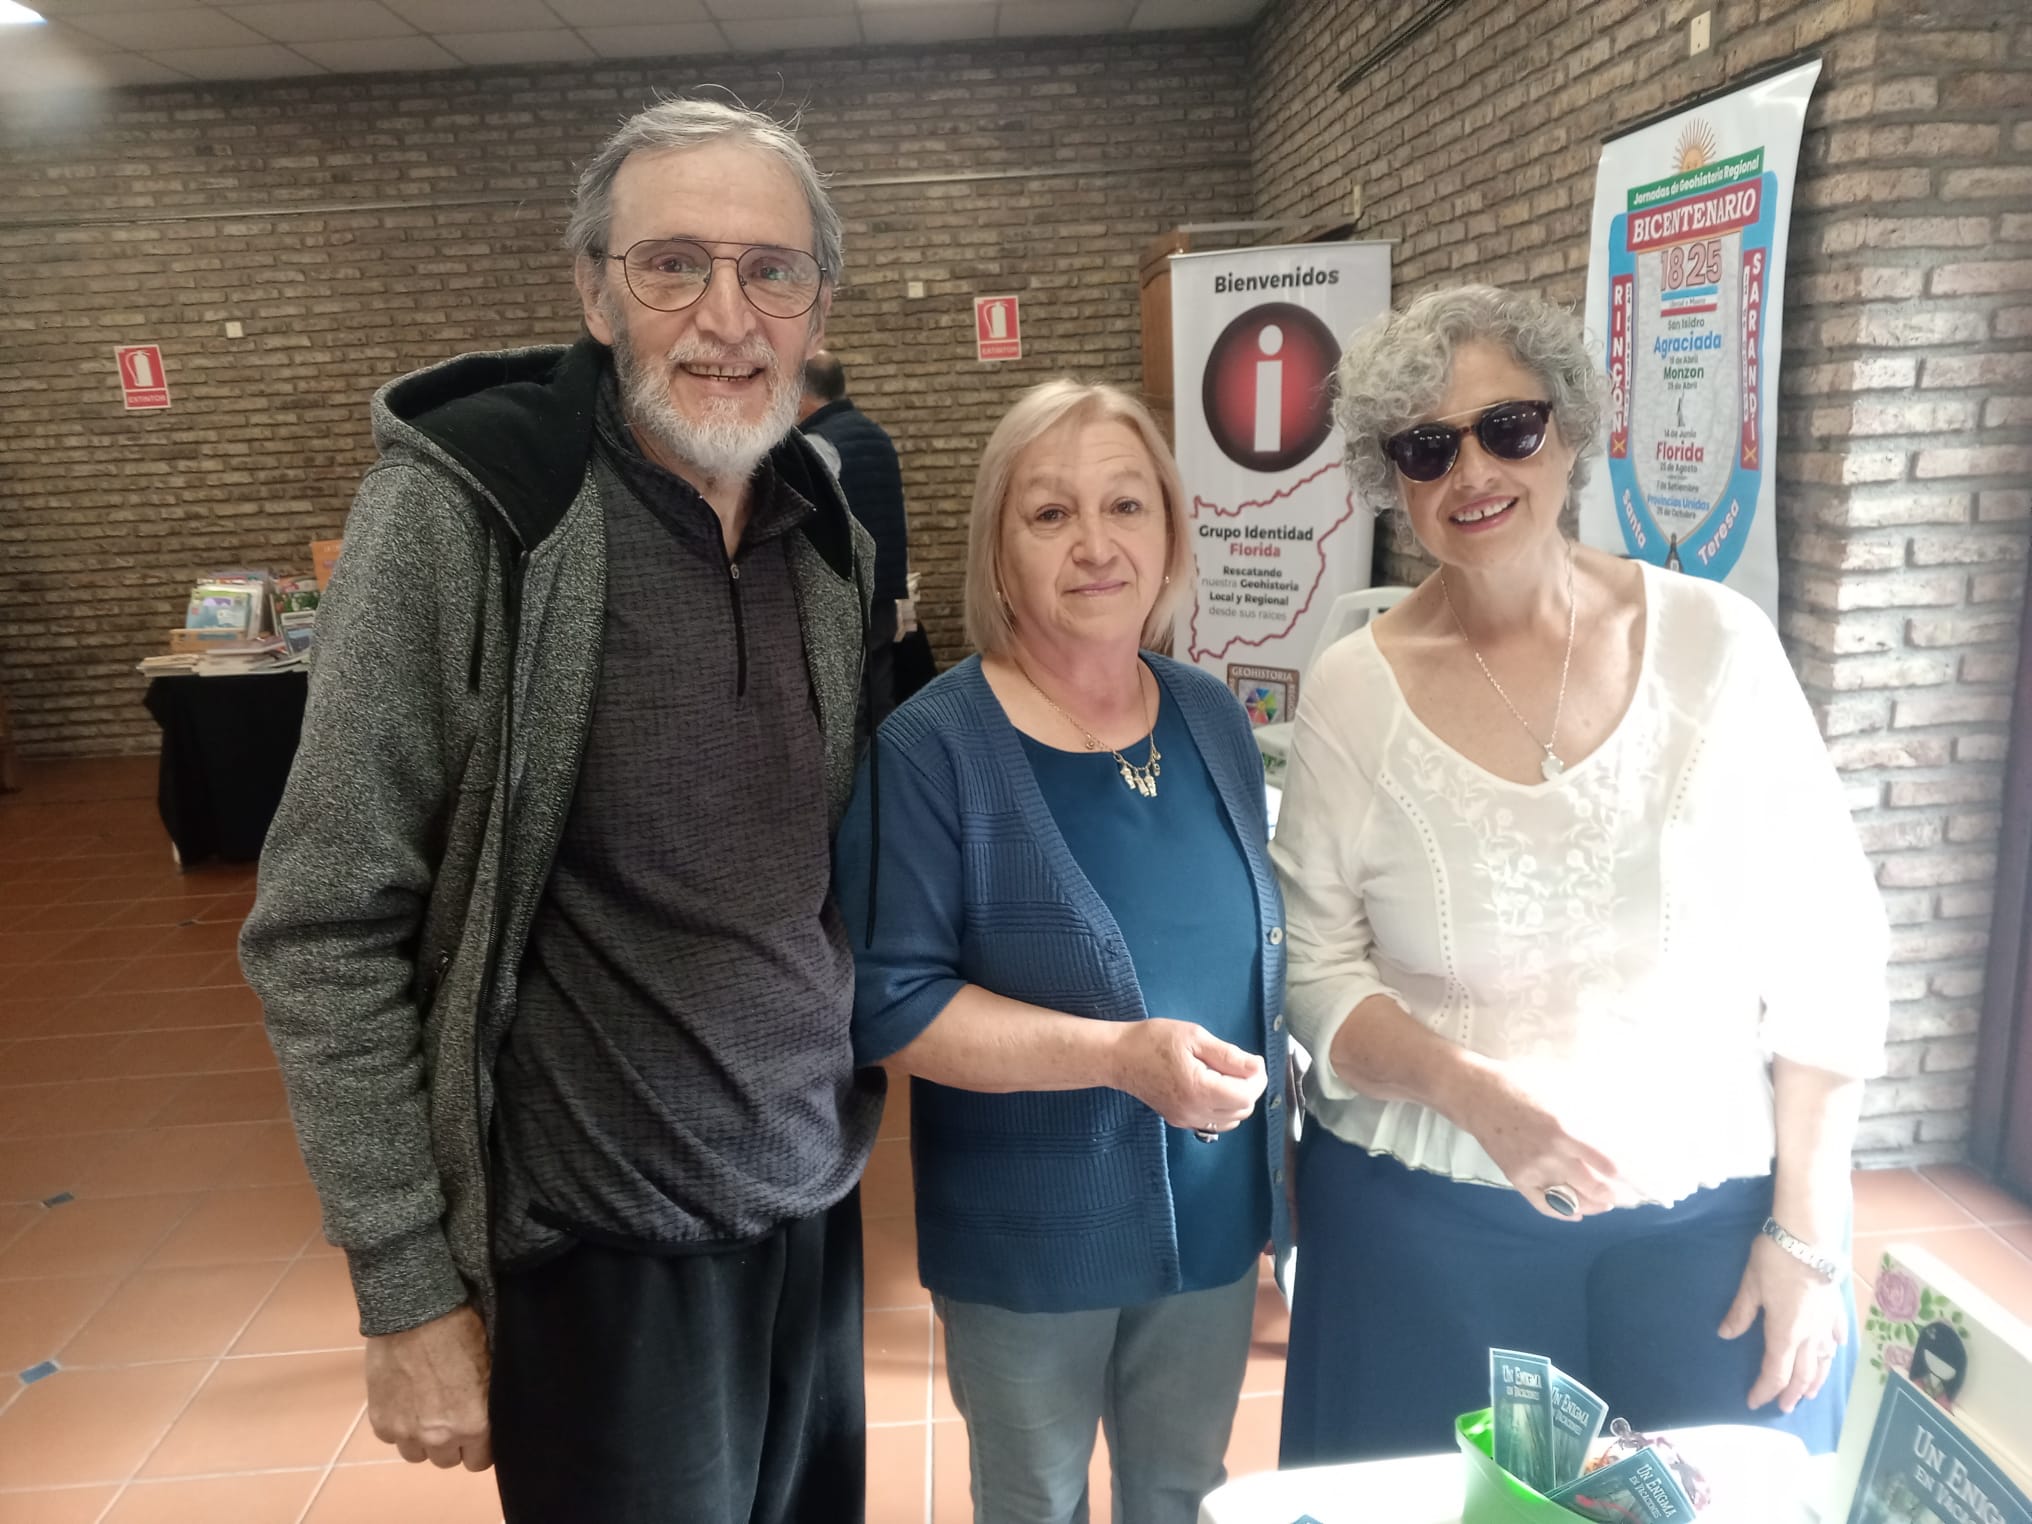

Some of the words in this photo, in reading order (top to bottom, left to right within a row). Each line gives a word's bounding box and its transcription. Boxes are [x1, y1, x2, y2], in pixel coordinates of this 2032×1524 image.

[1633, 185, 1670, 205] Jornadas
[1679, 168, 1723, 191] Geohistoria
[1724, 155, 1760, 181] Regional
[1632, 188, 1757, 243] BICENTENARIO
[1660, 240, 1723, 291] 1825
[1214, 267, 1340, 293] Bienvenidos
[1668, 320, 1680, 330] San
[1682, 317, 1705, 329] Isidro
[1654, 330, 1722, 359] Agraciada
[1664, 366, 1704, 380] Monzon
[1656, 440, 1704, 462] Florida
[1622, 488, 1647, 549] Santa
[1199, 524, 1241, 541] Grupo
[1245, 525, 1313, 541] Identidad
[1697, 499, 1740, 566] Teresa
[1230, 542, 1281, 557] Florida
[1223, 565, 1283, 577] Rescatando
[1201, 577, 1237, 588] nuestra
[1240, 578, 1299, 591] Geohistoria
[1209, 591, 1234, 602] Local
[1236, 594, 1242, 604] y
[1244, 593, 1289, 606] Regional
[1209, 605, 1237, 616] desde
[1239, 609, 1256, 618] sus
[1231, 665, 1293, 682] GEOHISTORIA
[1913, 1425, 1947, 1474] UN
[1913, 1464, 1935, 1491] EN
[1636, 1463, 1653, 1482] UN
[1646, 1477, 1677, 1518] ENIGMA
